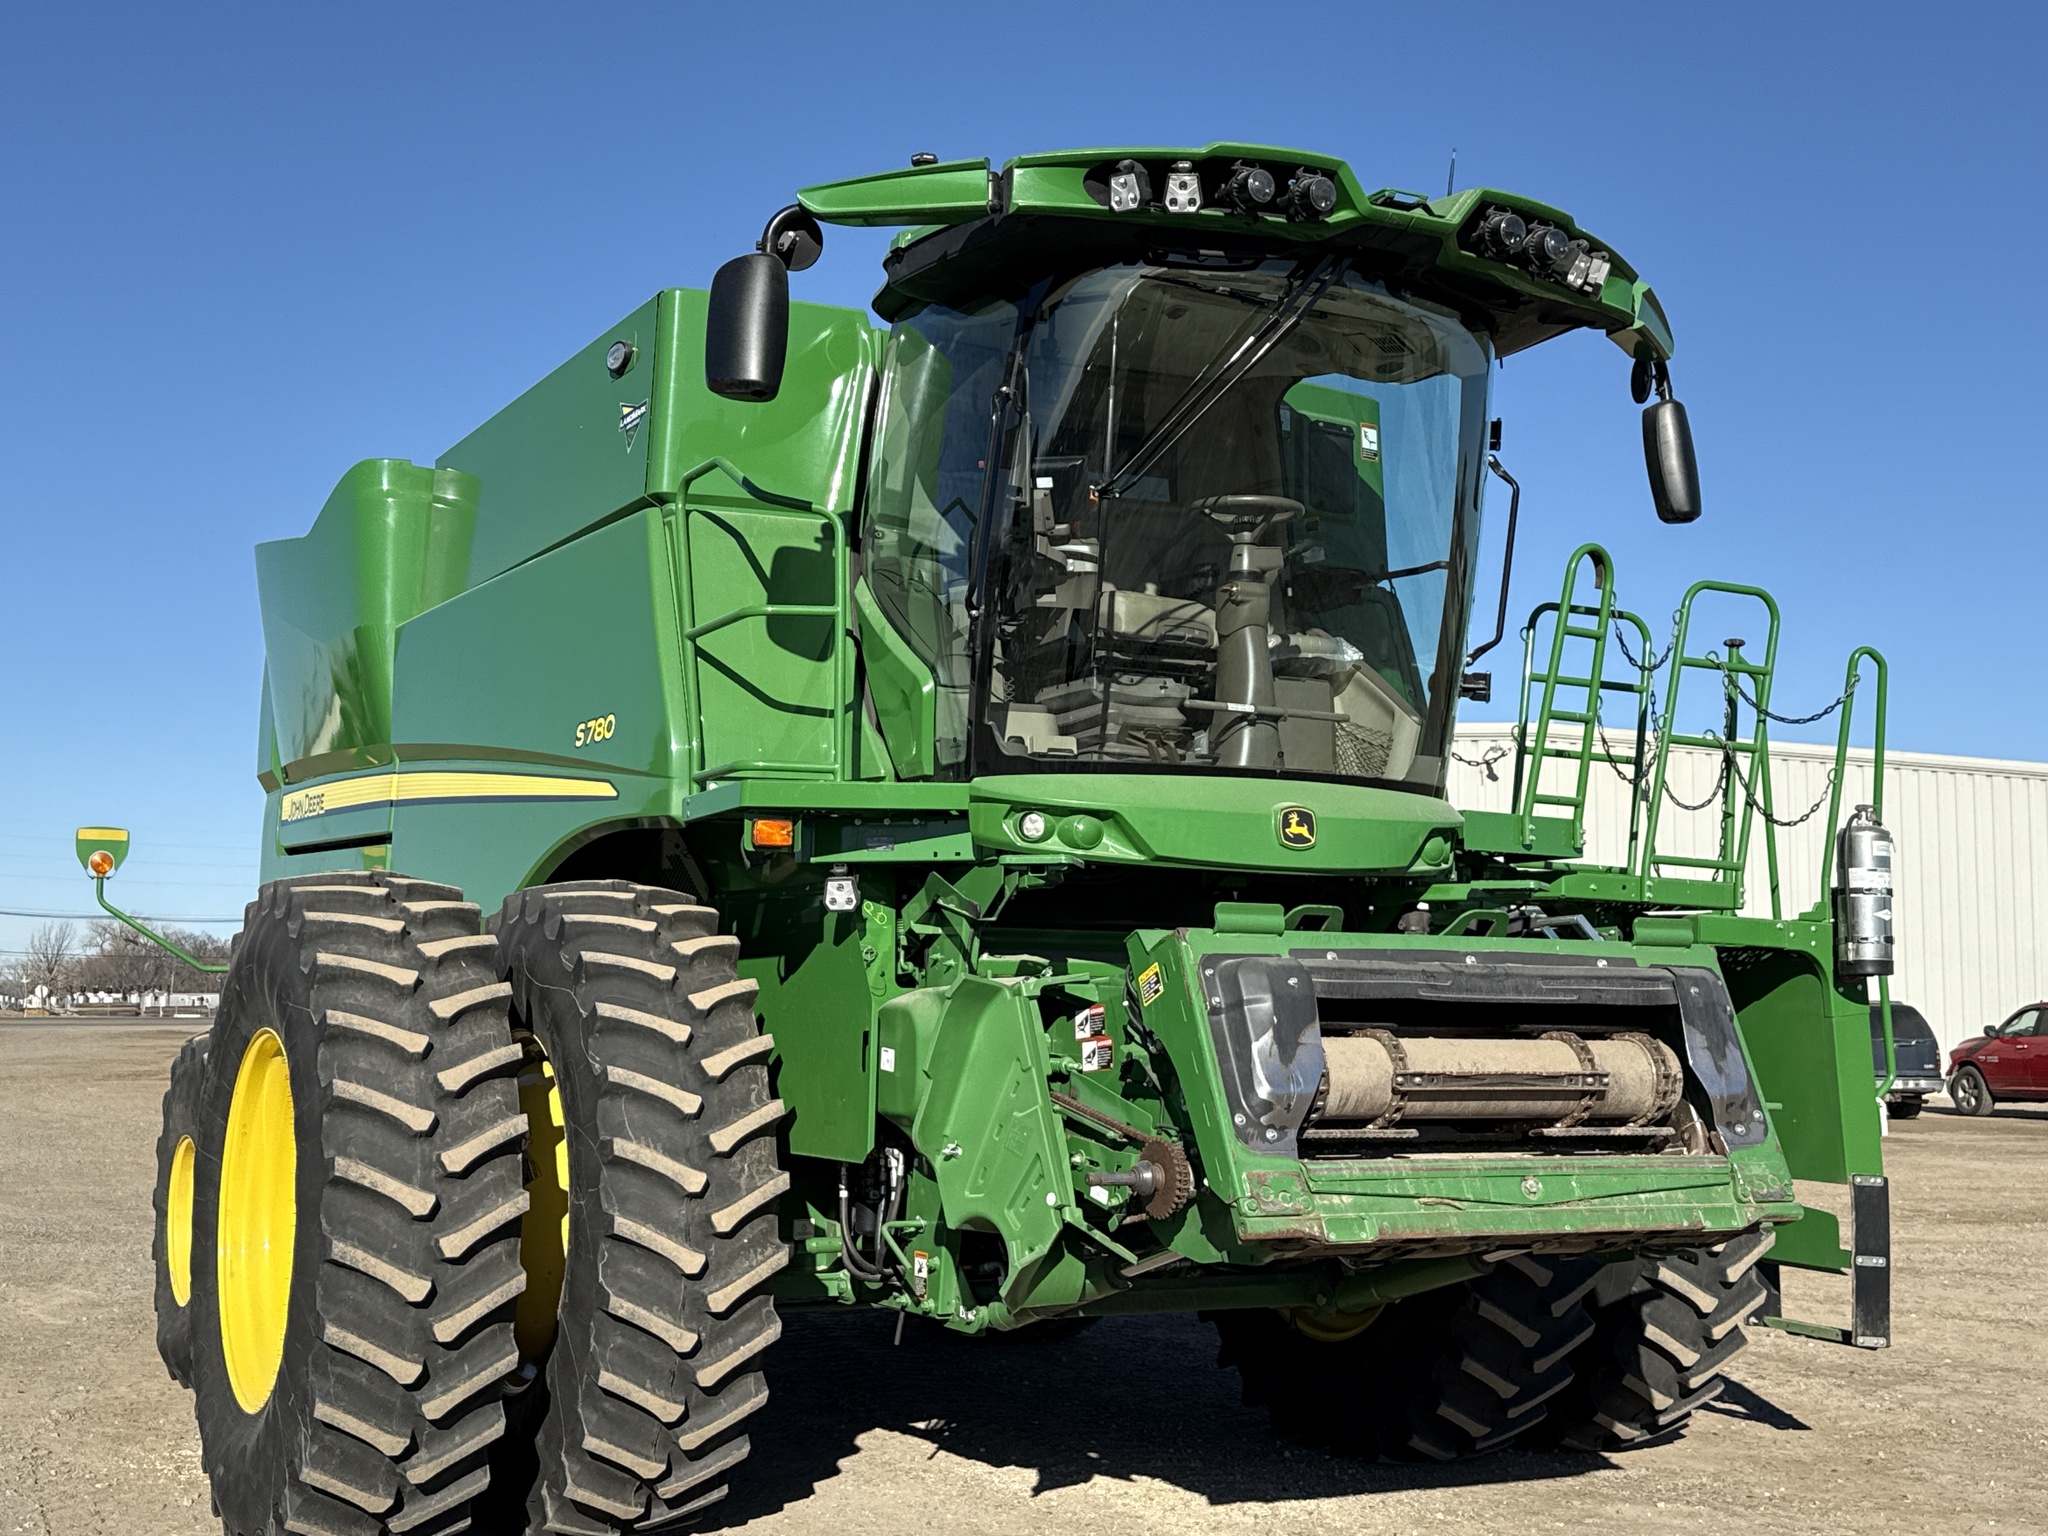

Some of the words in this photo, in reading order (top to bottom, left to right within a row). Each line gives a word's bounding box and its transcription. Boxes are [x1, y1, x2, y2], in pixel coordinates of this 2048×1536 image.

[574, 712, 616, 748] S780
[289, 799, 305, 819] JOHN
[304, 793, 325, 814] DEERE
